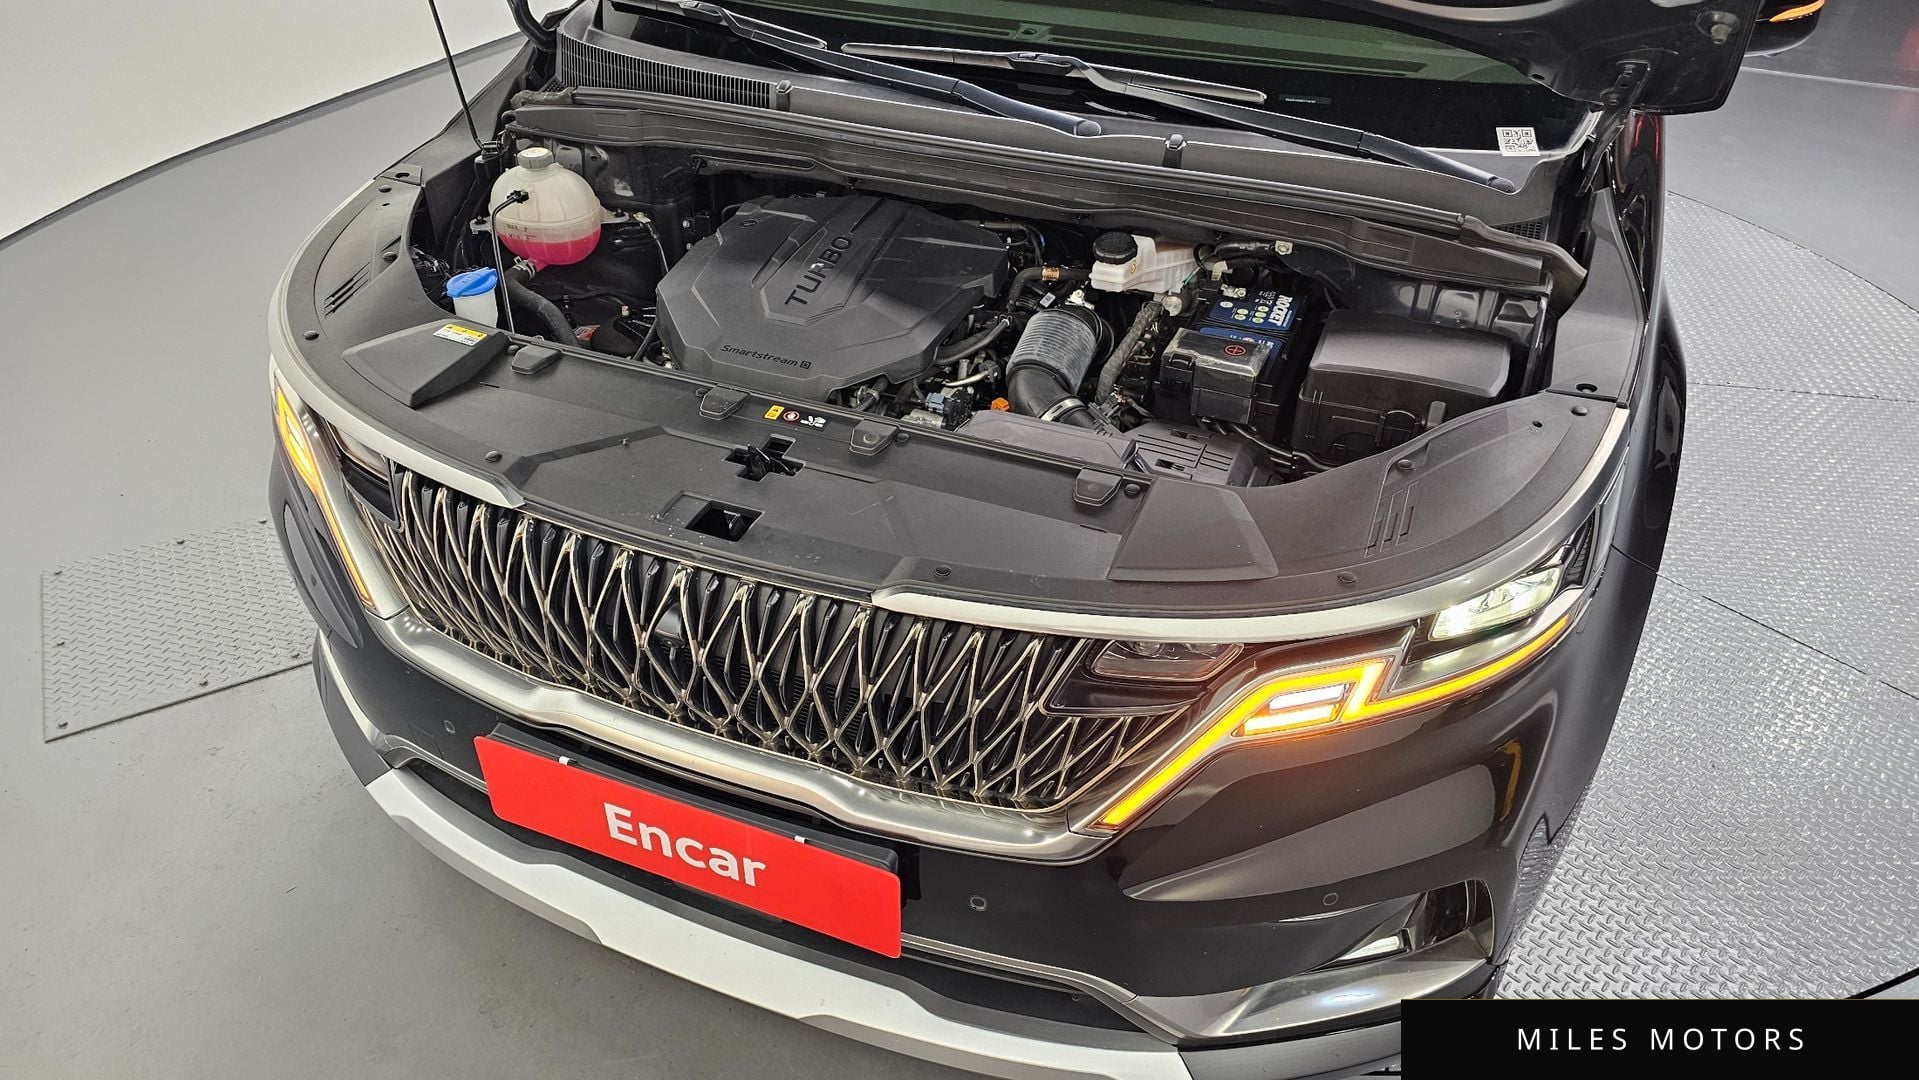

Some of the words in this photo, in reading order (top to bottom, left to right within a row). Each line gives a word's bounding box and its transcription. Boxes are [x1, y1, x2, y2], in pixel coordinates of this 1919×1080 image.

[784, 236, 852, 305] TURBO
[1268, 294, 1294, 327] ROCKET
[720, 344, 798, 367] Smartstream
[604, 803, 766, 887] Encar
